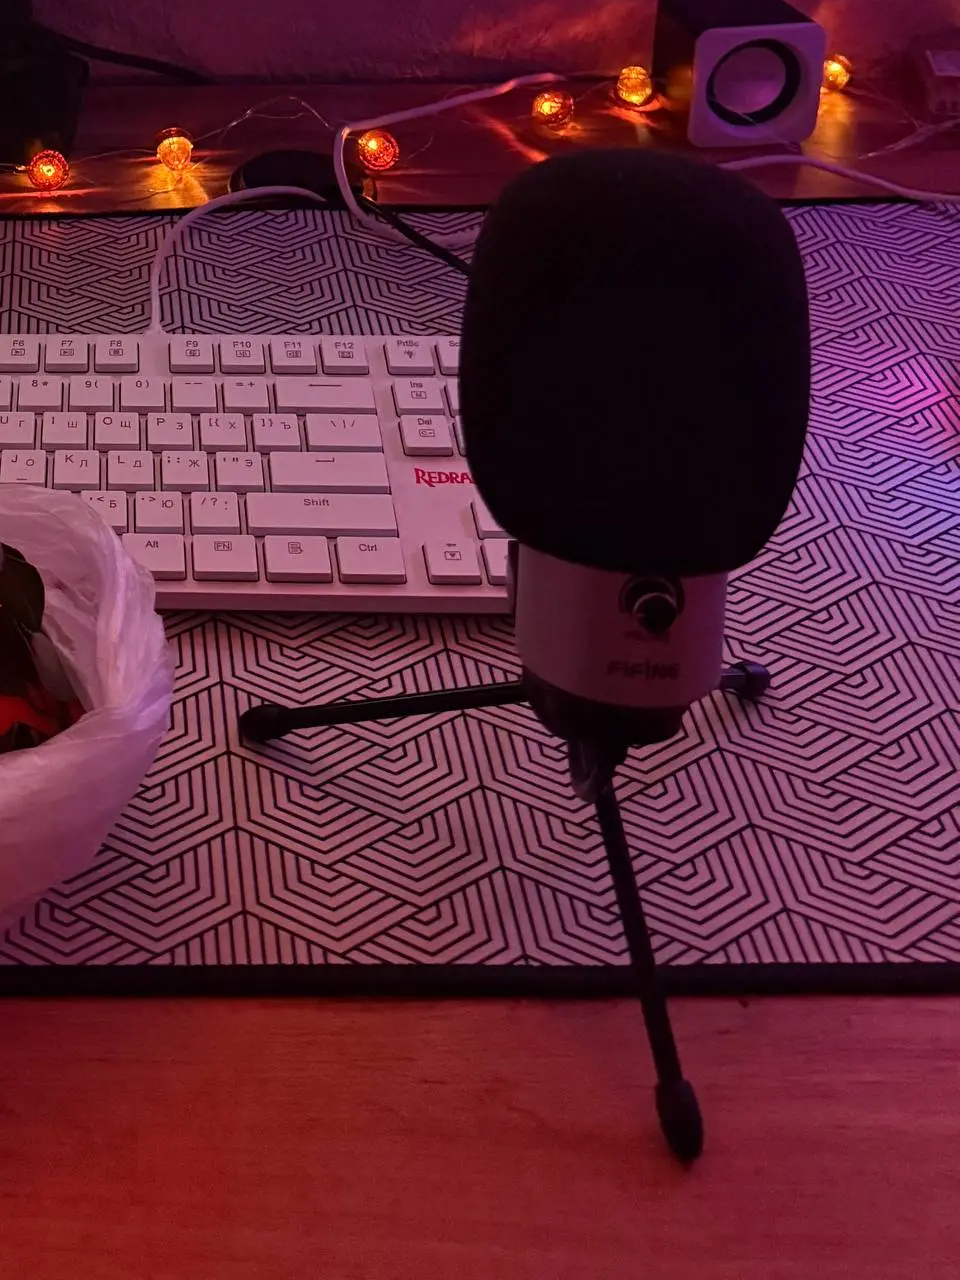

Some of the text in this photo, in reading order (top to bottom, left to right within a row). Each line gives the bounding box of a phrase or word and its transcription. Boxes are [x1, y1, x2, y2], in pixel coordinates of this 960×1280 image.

[61, 340, 73, 348] F7
[110, 340, 122, 348] F8
[233, 341, 252, 349] F10
[334, 342, 354, 350] F12
[0, 416, 8, 424] U
[11, 455, 18, 463] J
[65, 455, 74, 463] K
[117, 455, 126, 464] L
[414, 467, 475, 487] REDRA
[303, 498, 330, 506] Shift
[145, 540, 159, 549] Alt
[358, 543, 378, 552] Ctrl
